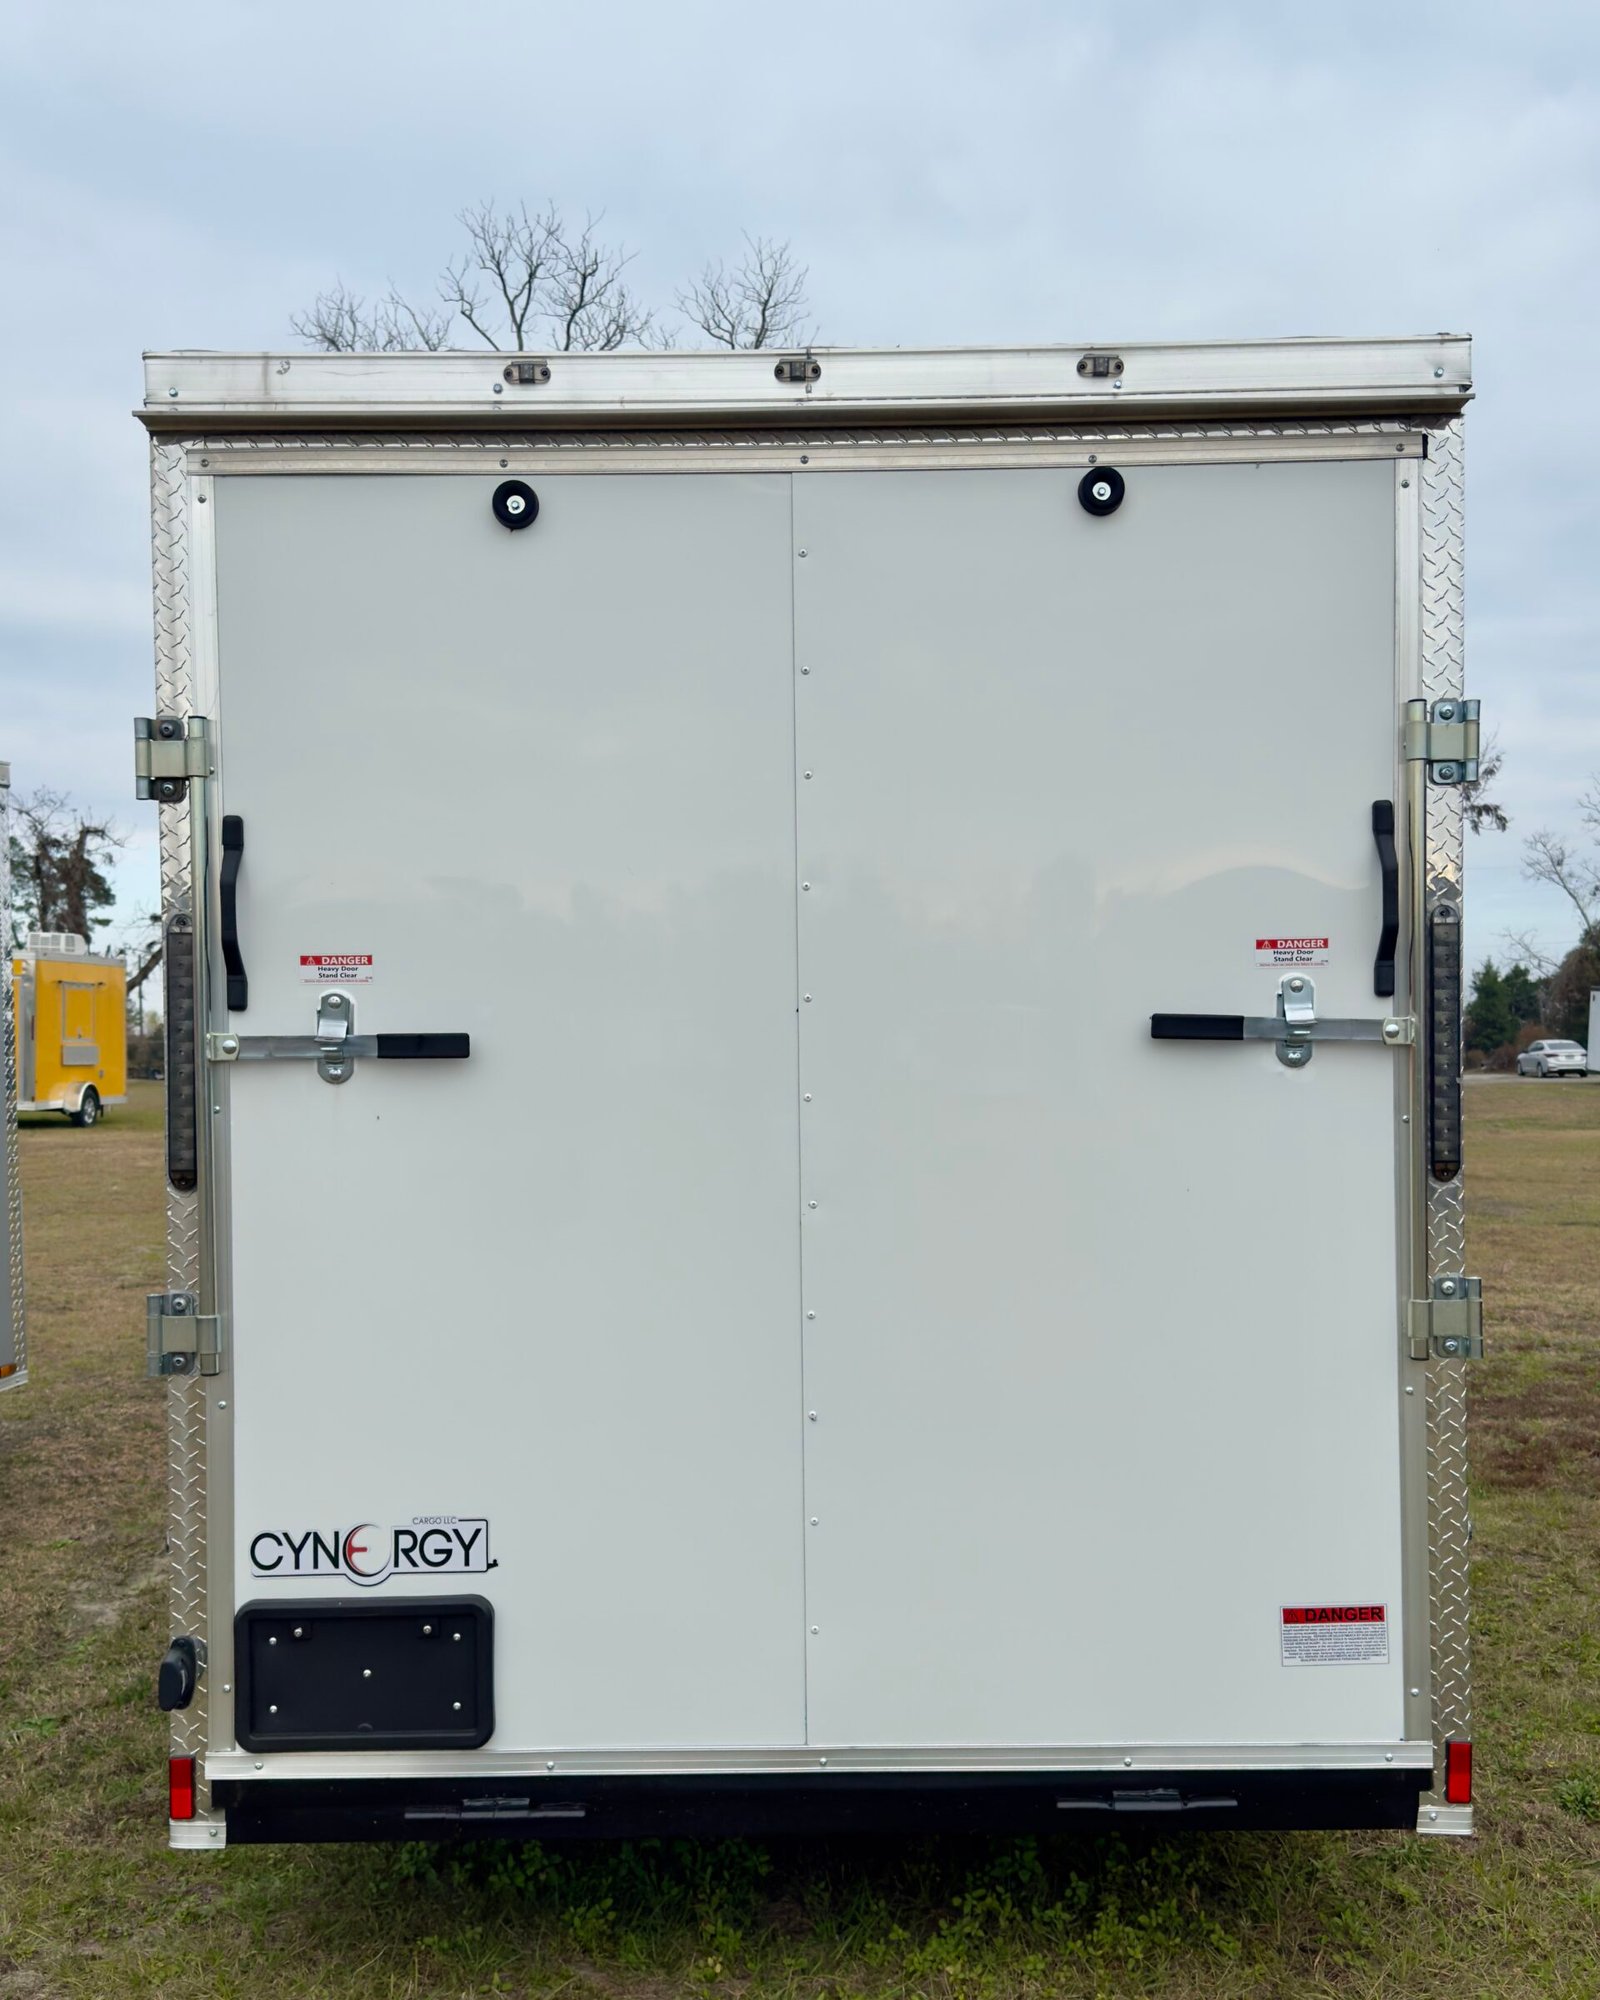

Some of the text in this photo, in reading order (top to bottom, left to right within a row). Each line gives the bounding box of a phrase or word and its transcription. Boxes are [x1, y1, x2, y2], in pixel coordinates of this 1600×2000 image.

[1277, 940, 1325, 949] DANGER
[321, 956, 369, 965] DANGER
[412, 1517, 442, 1525] CARGO
[250, 1525, 482, 1577] CYNERGY
[1304, 1607, 1383, 1622] DANGER
